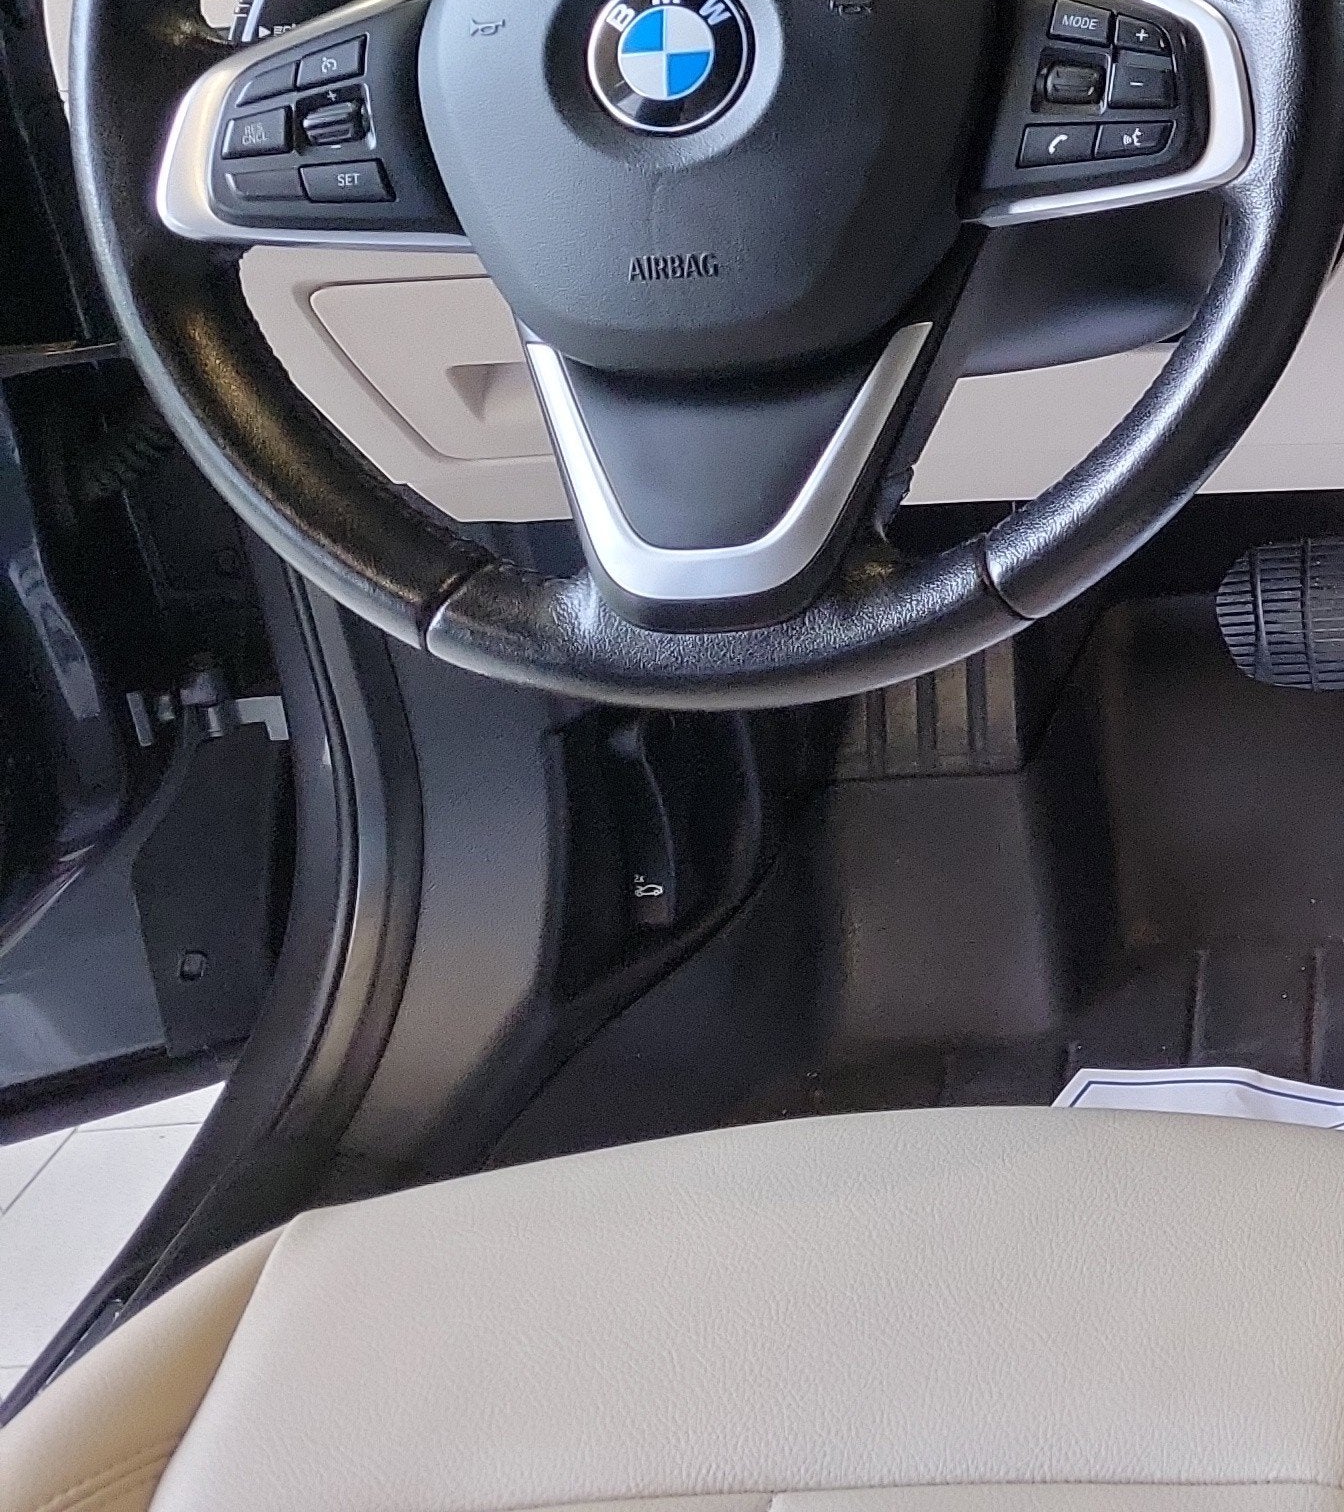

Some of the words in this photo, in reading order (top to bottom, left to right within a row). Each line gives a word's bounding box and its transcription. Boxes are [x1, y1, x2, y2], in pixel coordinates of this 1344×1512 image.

[1061, 14, 1099, 31] MODE
[337, 174, 361, 187] SET
[628, 252, 719, 282] AIRBAG
